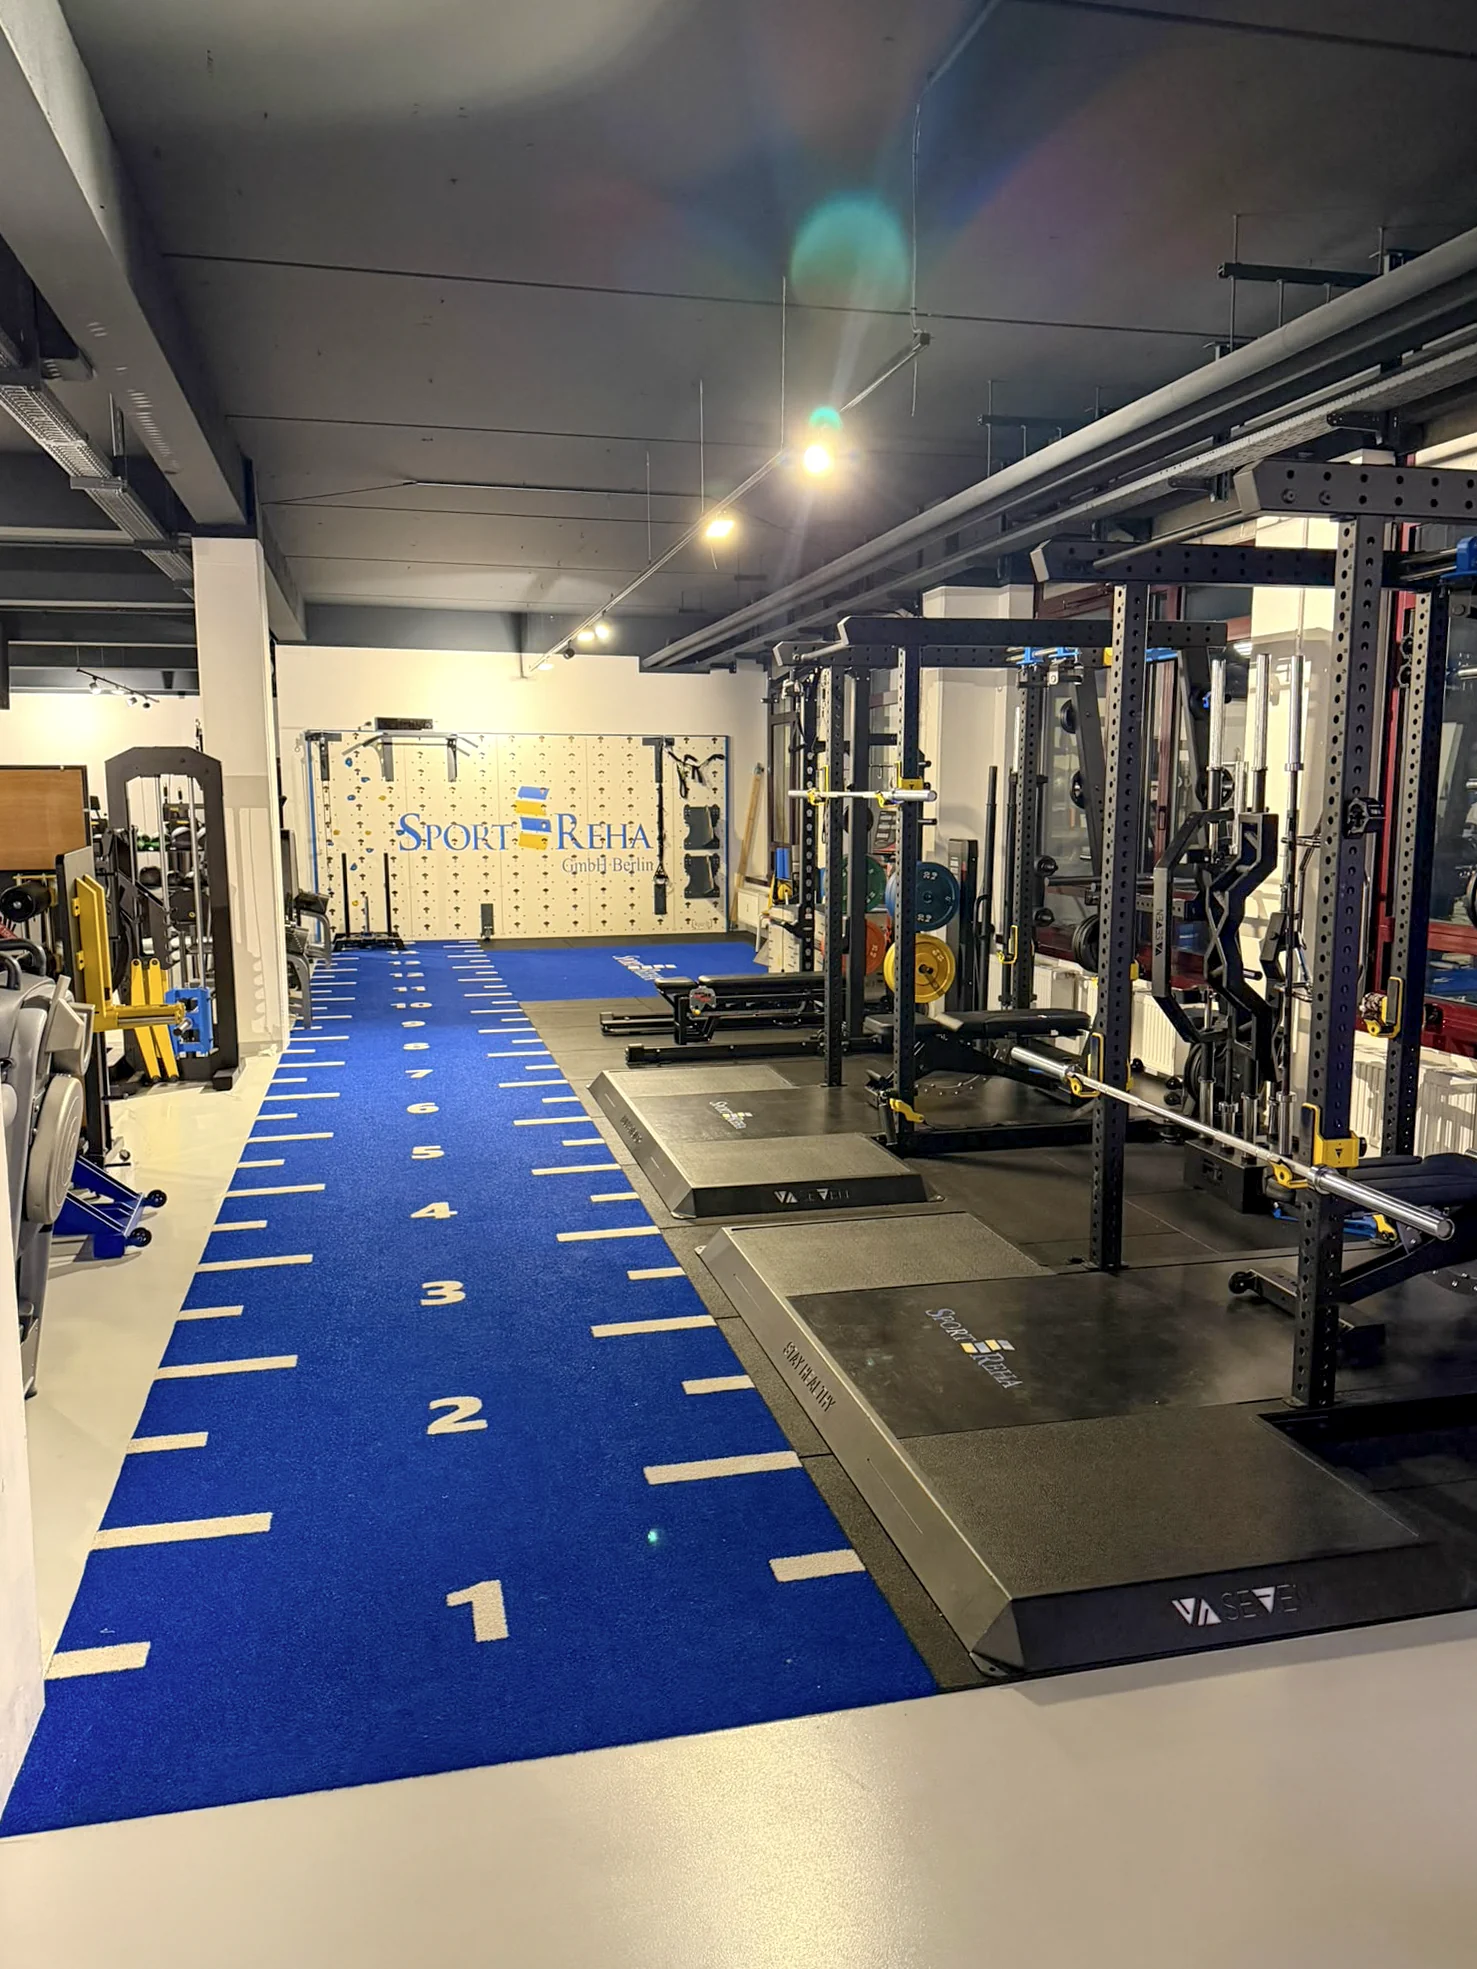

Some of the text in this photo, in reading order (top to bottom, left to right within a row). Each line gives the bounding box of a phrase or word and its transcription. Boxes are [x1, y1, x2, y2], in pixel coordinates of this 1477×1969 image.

[555, 812, 654, 851] REHA
[562, 856, 655, 876] GmbH Berlin
[405, 1069, 434, 1079] 7
[407, 1102, 440, 1114] 6
[411, 1145, 445, 1160] 5
[410, 1202, 458, 1219] 4
[420, 1280, 466, 1306] 3
[427, 1396, 488, 1435] 2
[446, 1579, 509, 1642] 1
